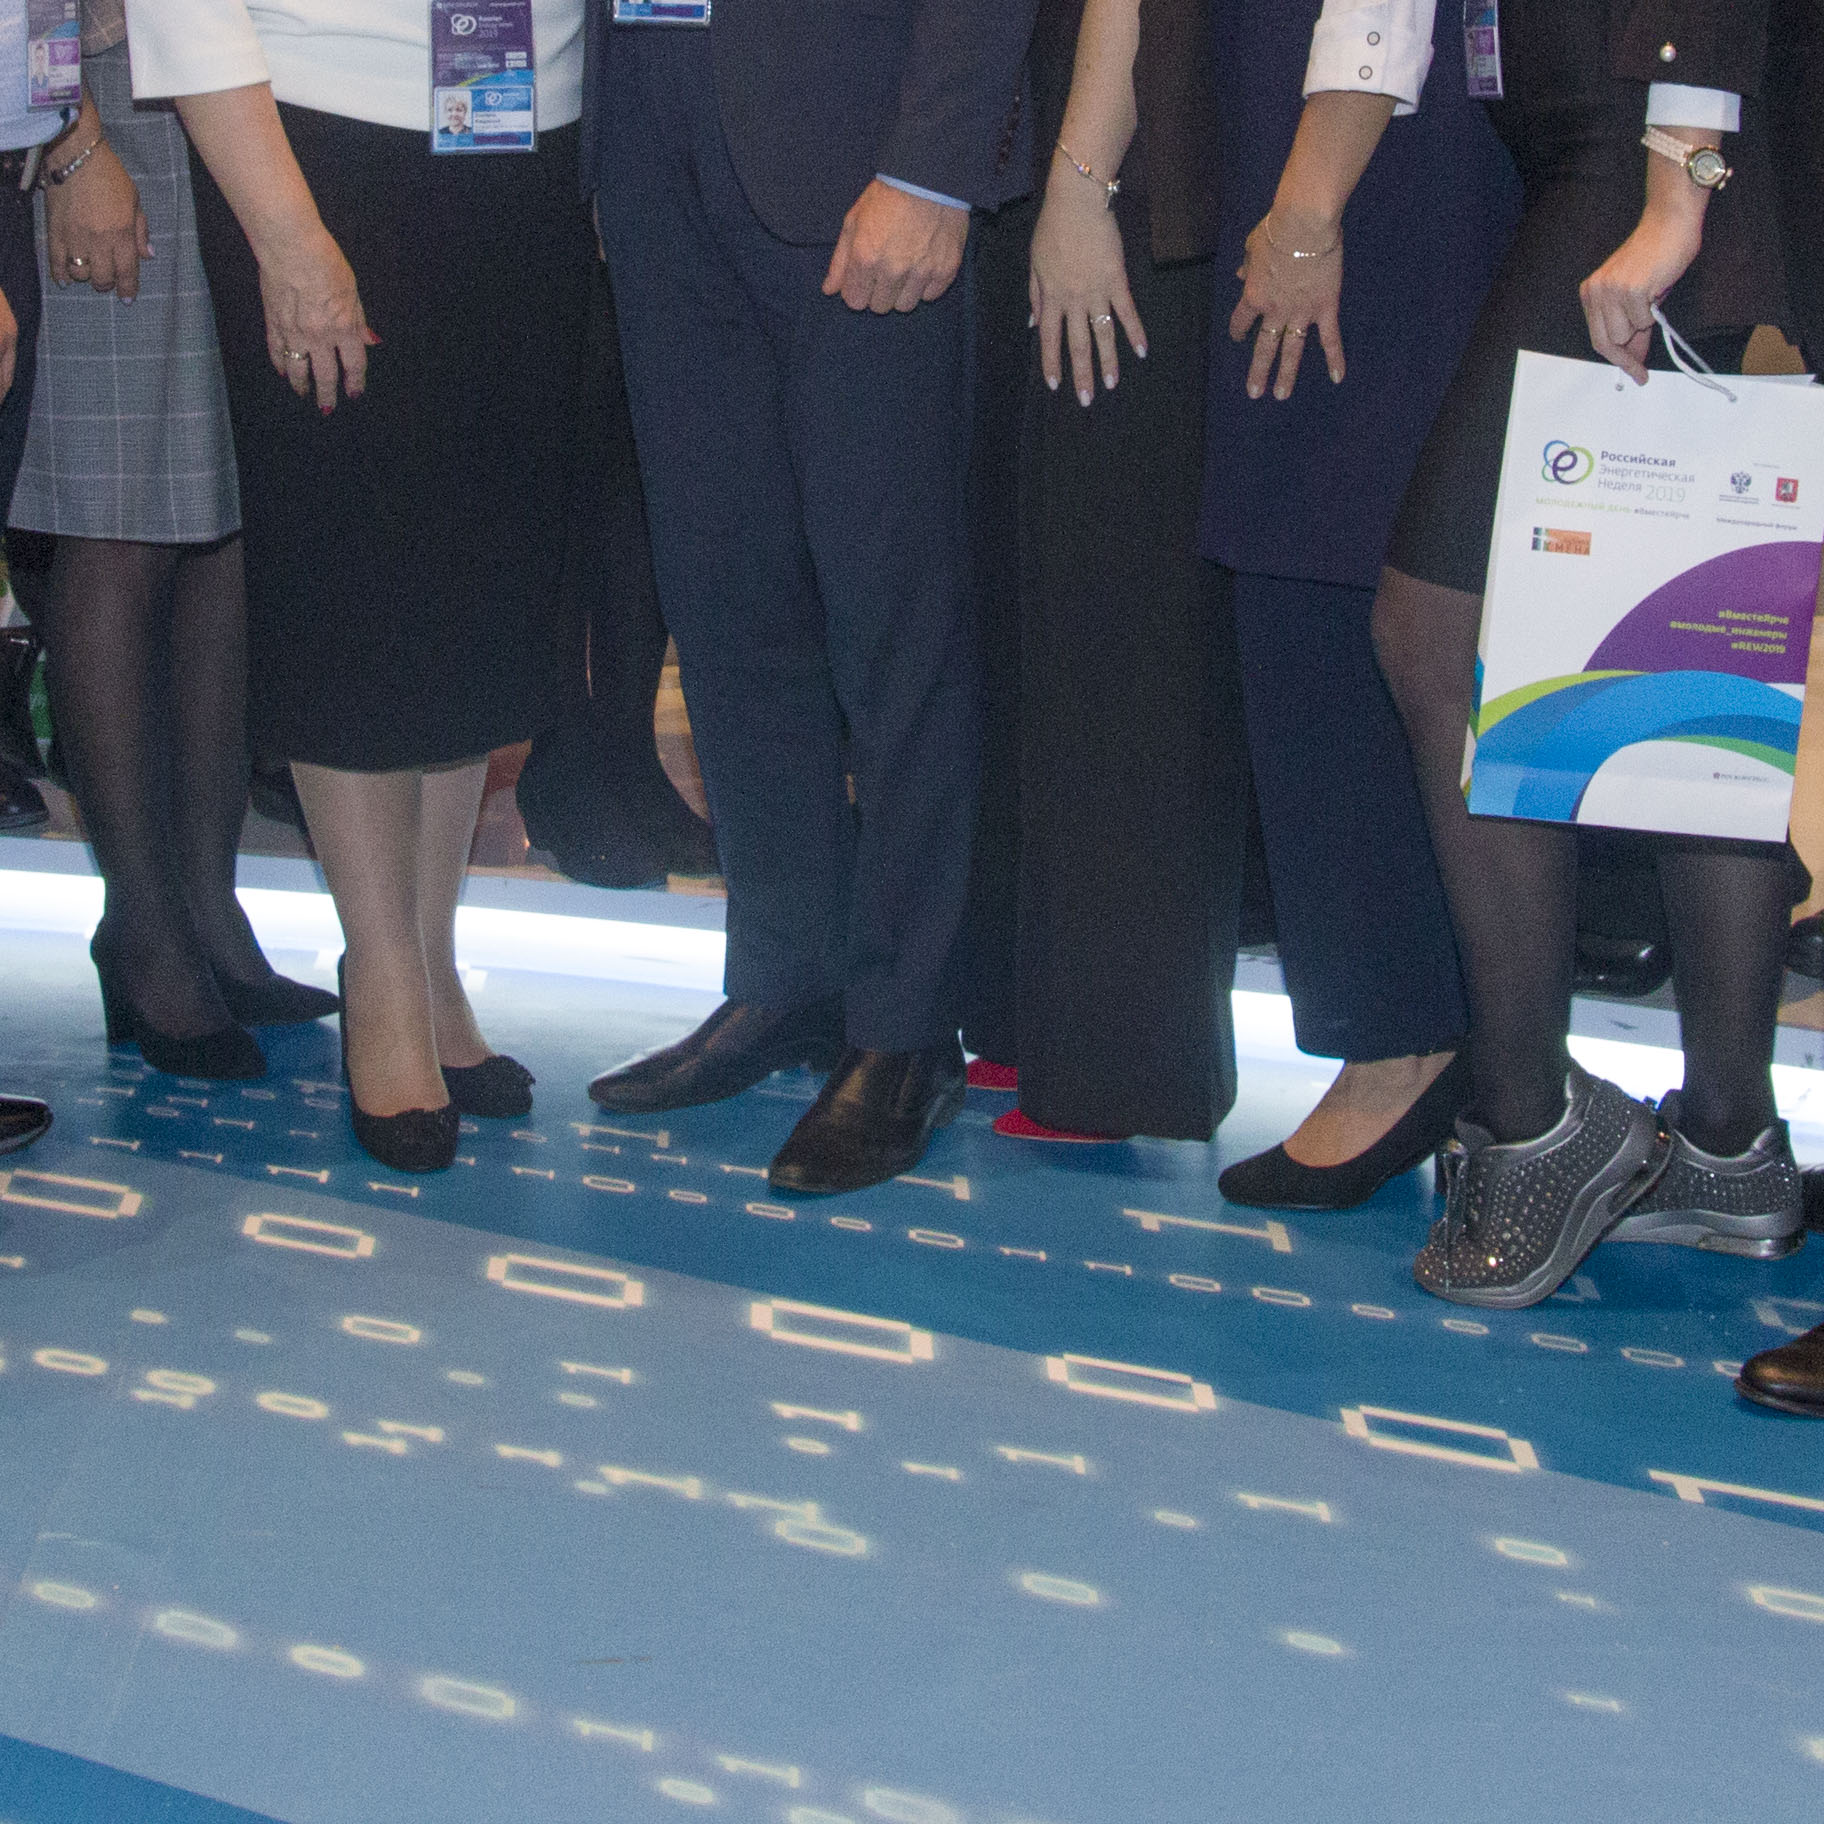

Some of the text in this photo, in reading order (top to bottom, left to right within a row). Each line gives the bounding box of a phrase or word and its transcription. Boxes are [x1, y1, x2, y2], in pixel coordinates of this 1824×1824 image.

[1600, 450, 1677, 468] Российская
[1598, 464, 1696, 484] Энергетическая
[1597, 478, 1687, 503] Неделя 2019
